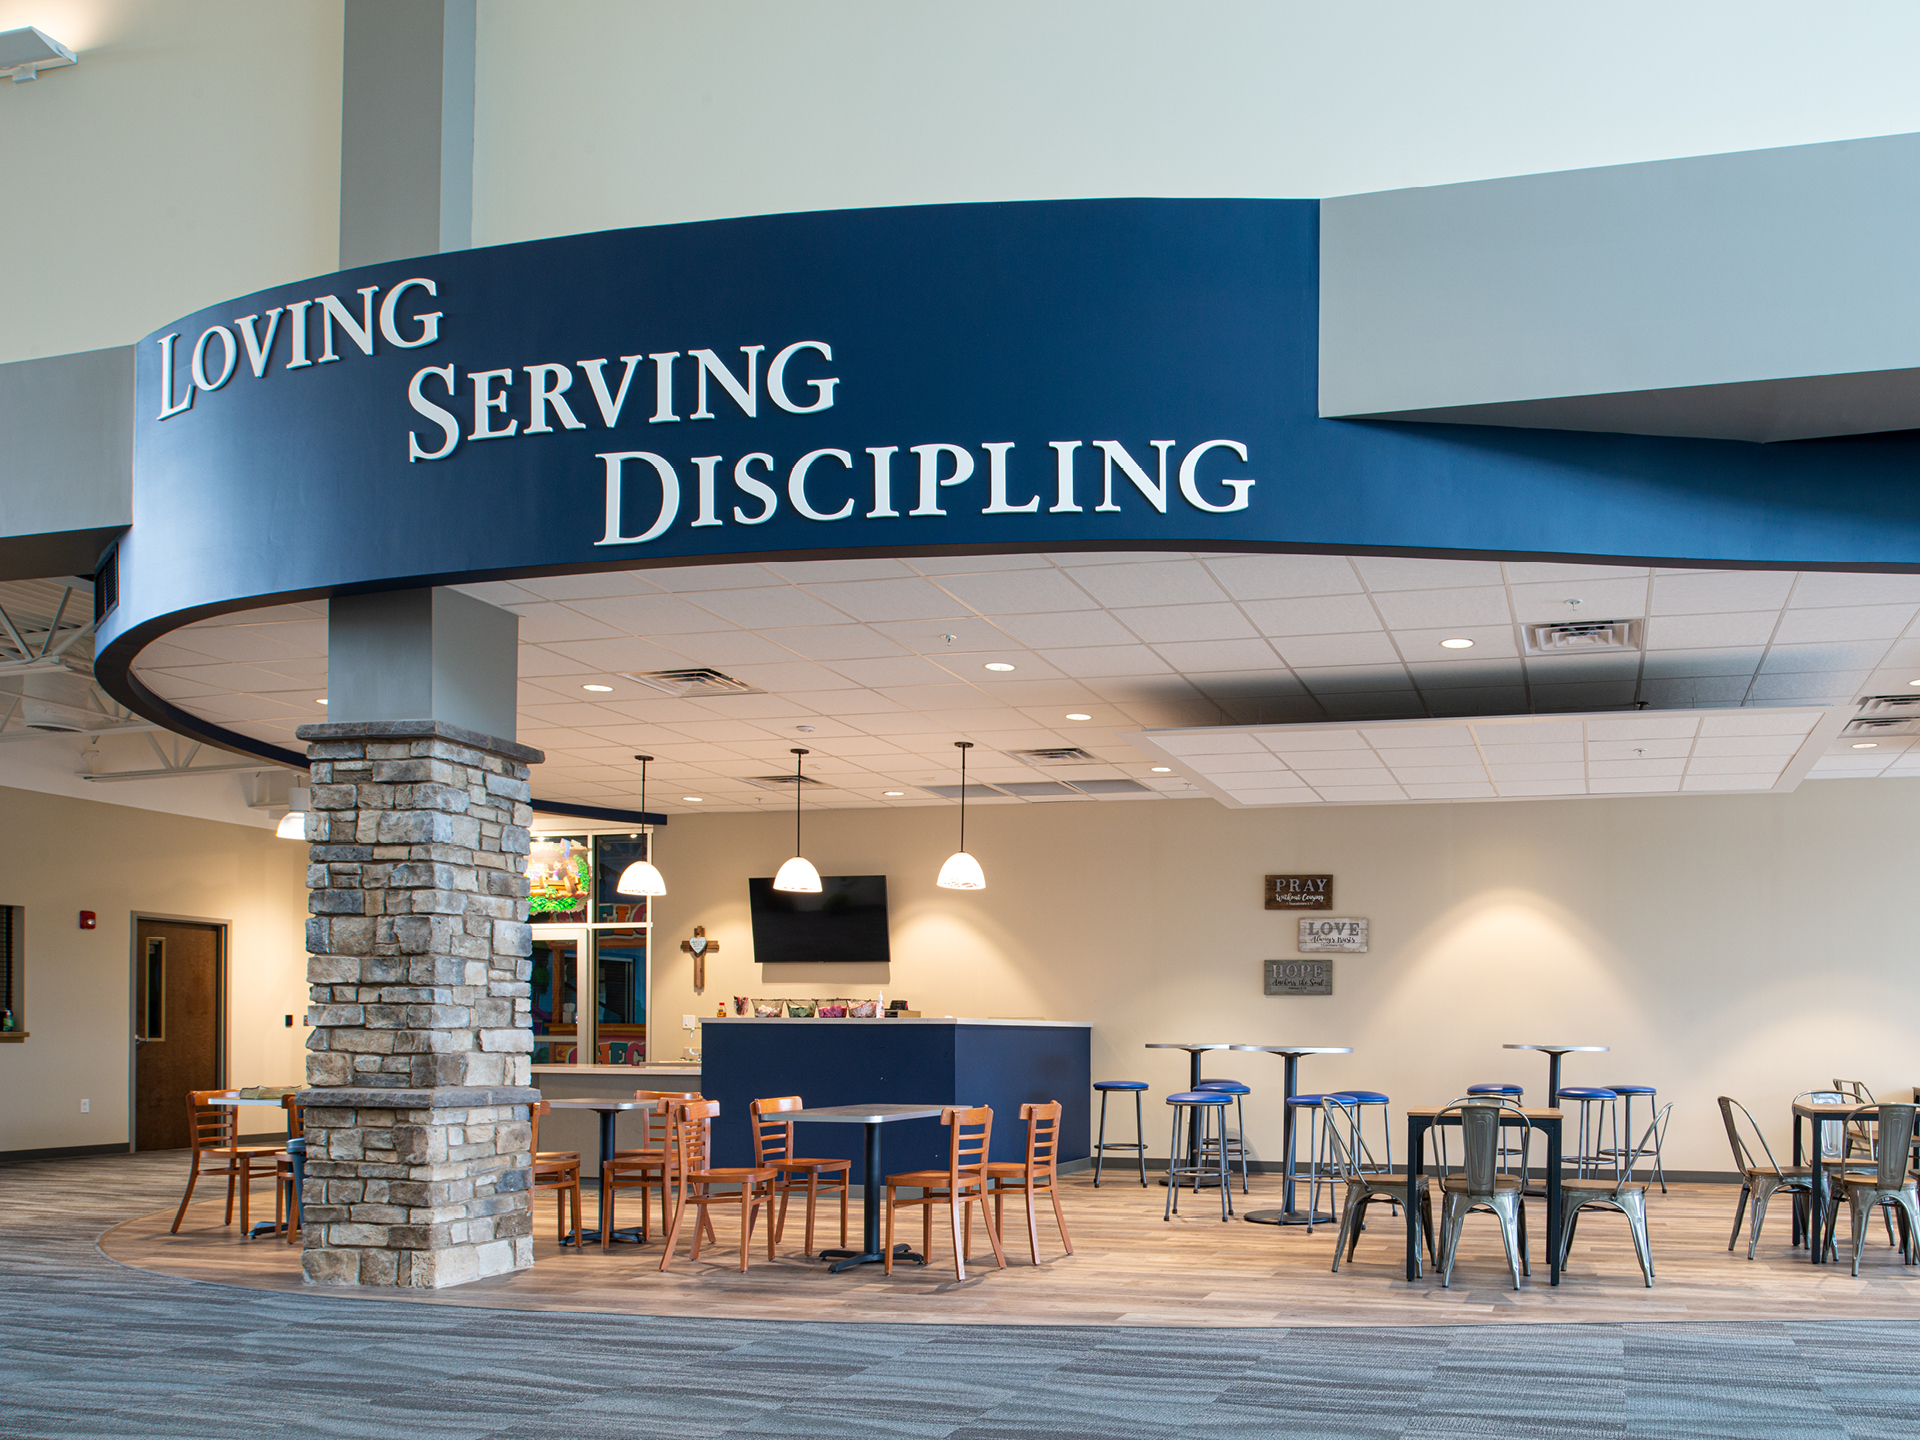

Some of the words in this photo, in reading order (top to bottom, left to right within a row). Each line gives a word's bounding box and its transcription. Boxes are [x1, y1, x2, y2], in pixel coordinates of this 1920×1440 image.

[1275, 878, 1328, 892] PRAY
[1307, 921, 1360, 936] LOVE
[1272, 964, 1324, 978] HOPE
